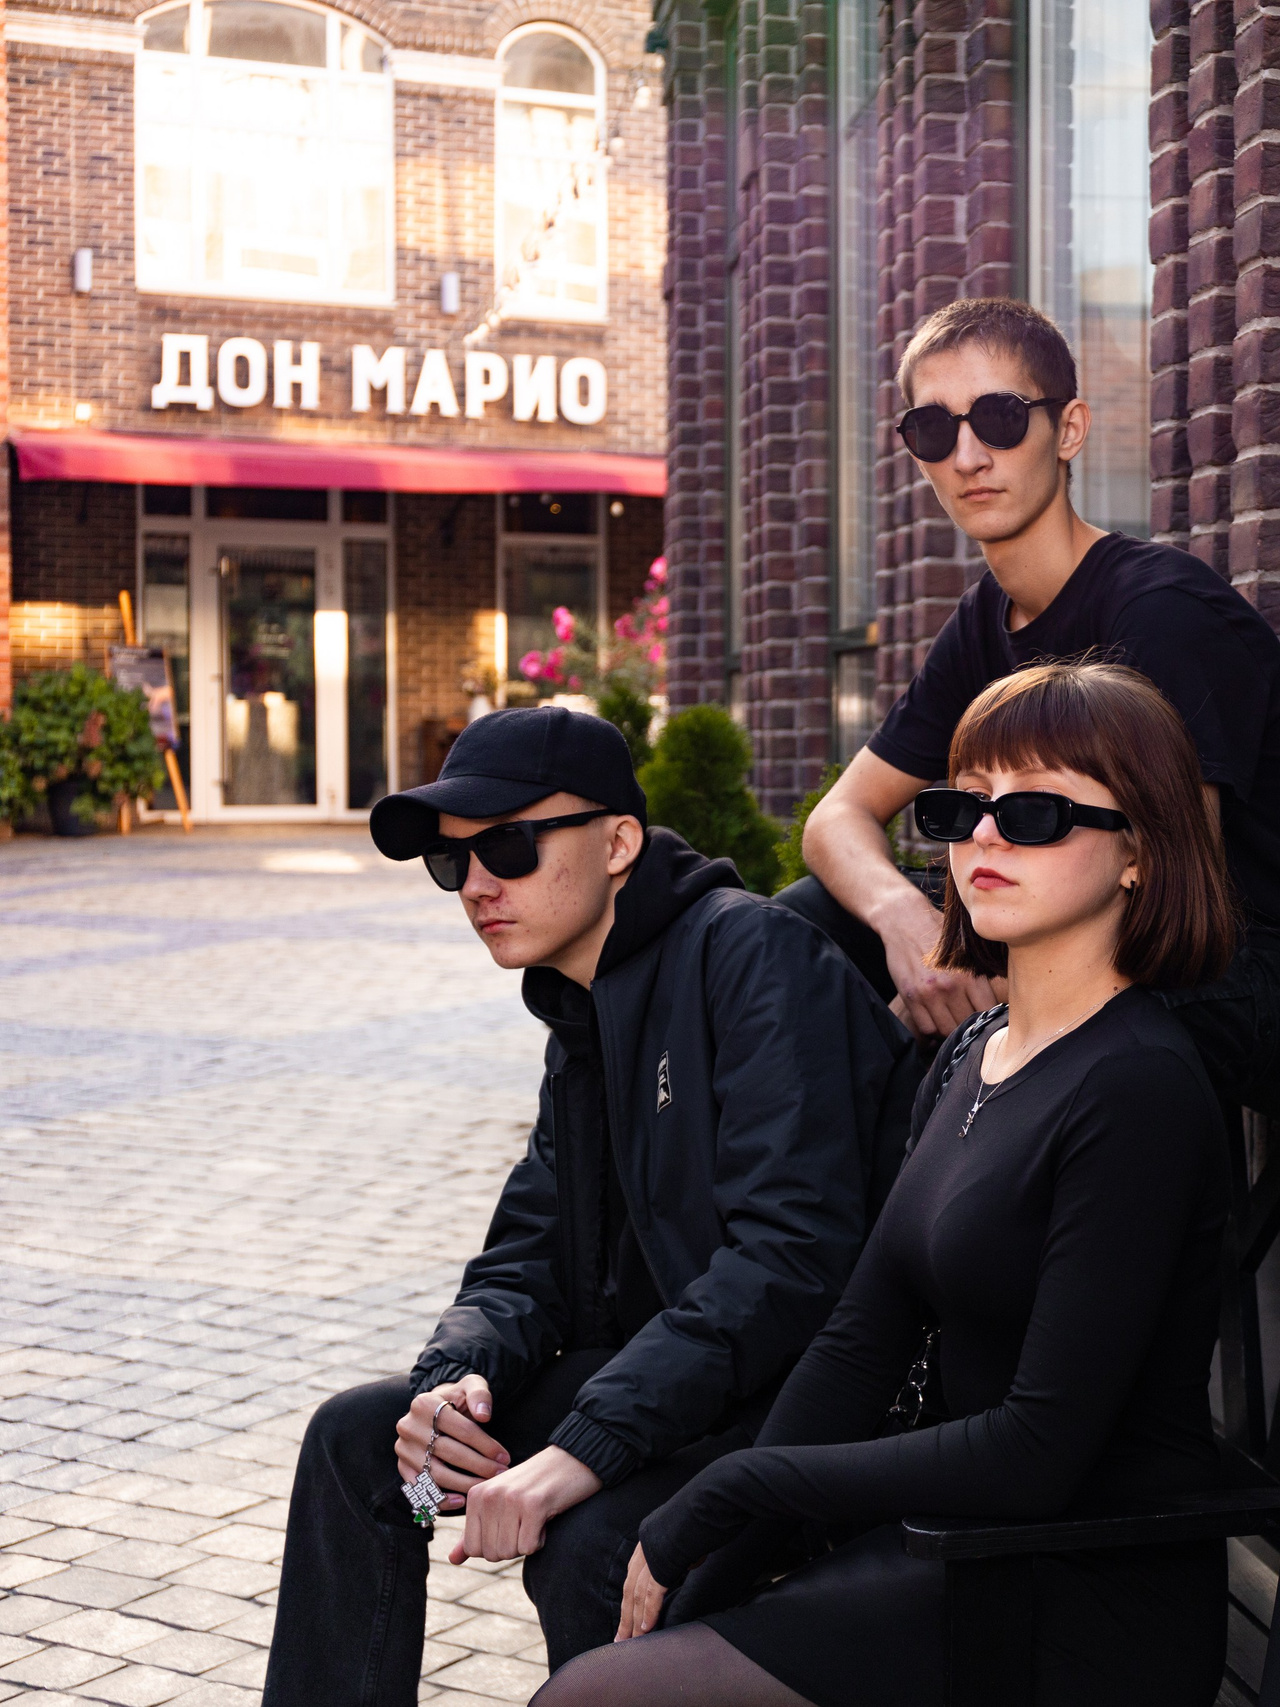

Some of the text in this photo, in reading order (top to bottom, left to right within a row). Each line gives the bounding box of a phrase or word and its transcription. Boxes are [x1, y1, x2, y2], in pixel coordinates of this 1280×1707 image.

[151, 332, 608, 425] ДОН МАРИО
[402, 1483, 423, 1508] auto
